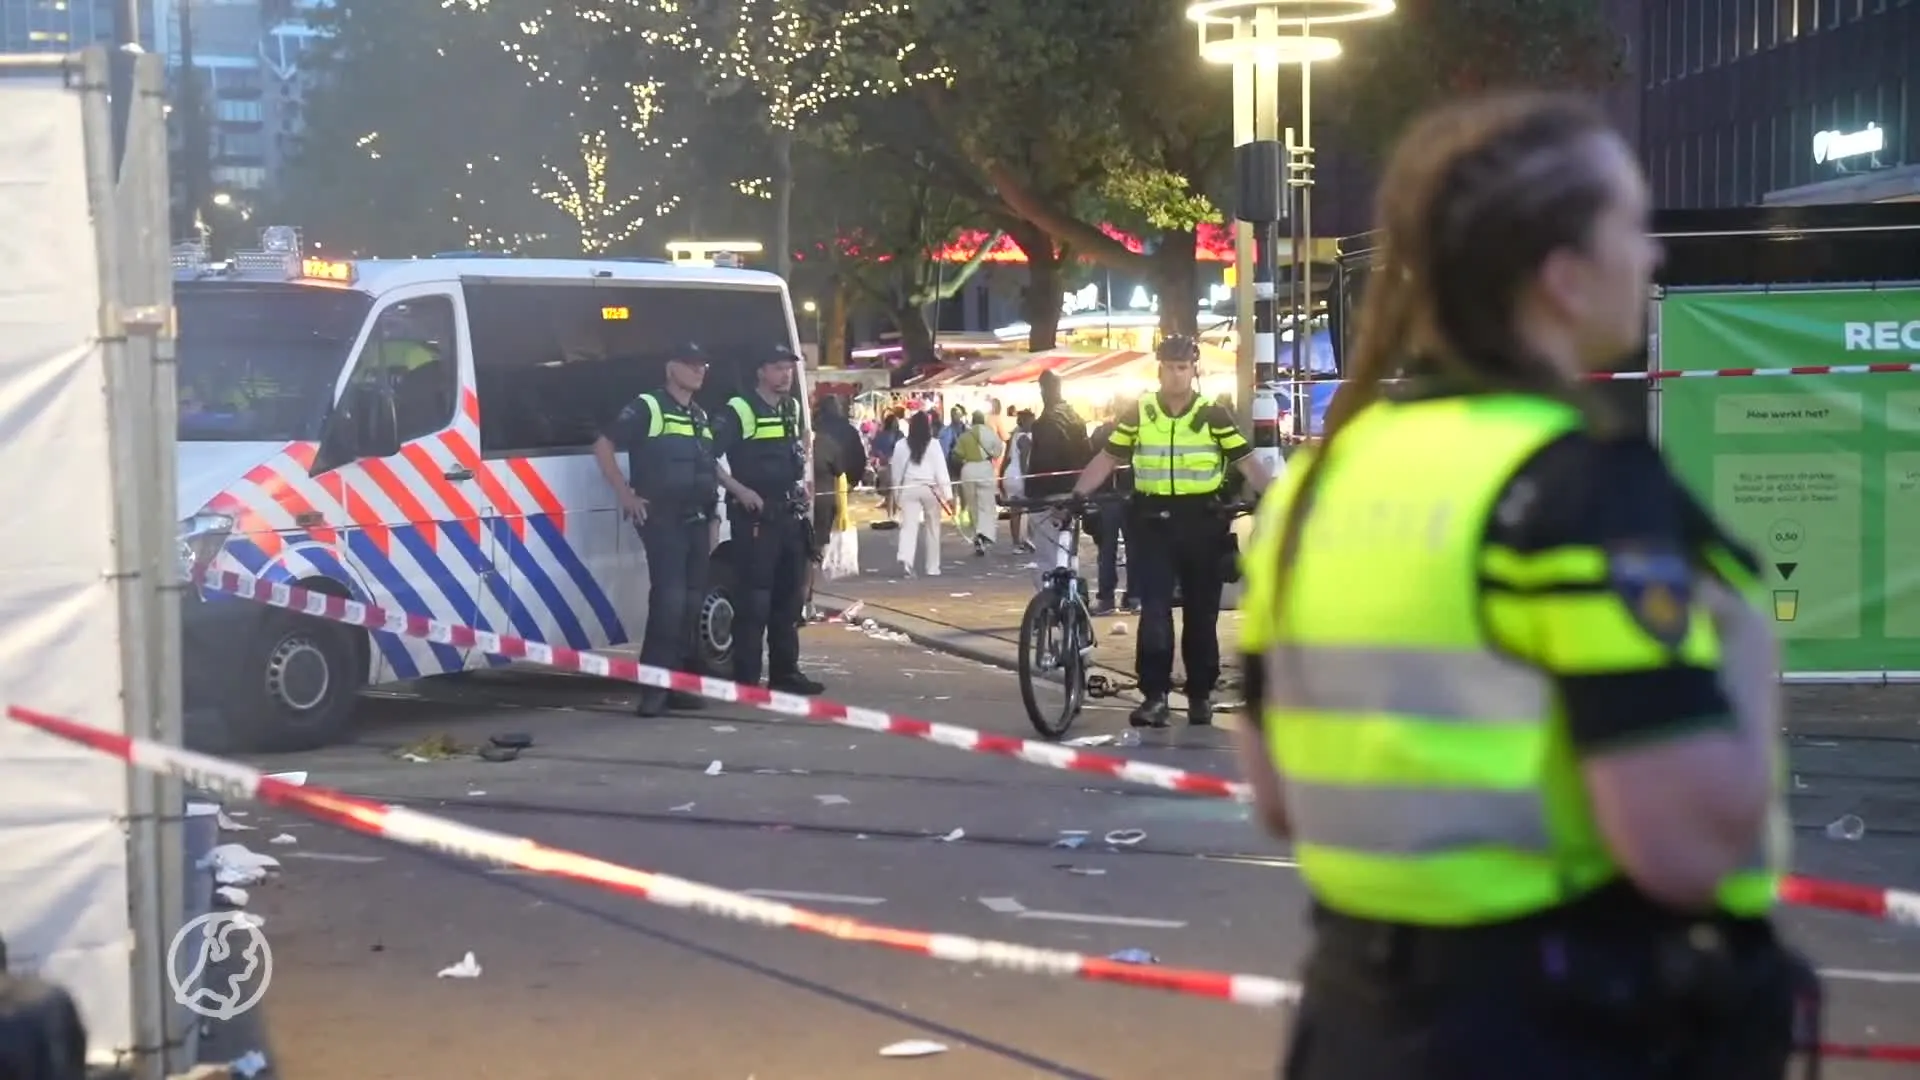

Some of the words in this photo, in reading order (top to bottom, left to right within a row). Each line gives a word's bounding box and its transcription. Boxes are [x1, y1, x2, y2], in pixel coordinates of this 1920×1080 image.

[1845, 320, 1920, 350] REC
[1746, 410, 1769, 419] Hoe
[1770, 409, 1803, 419] werkt
[1805, 409, 1830, 419] het?
[1775, 533, 1798, 542] 0,50
